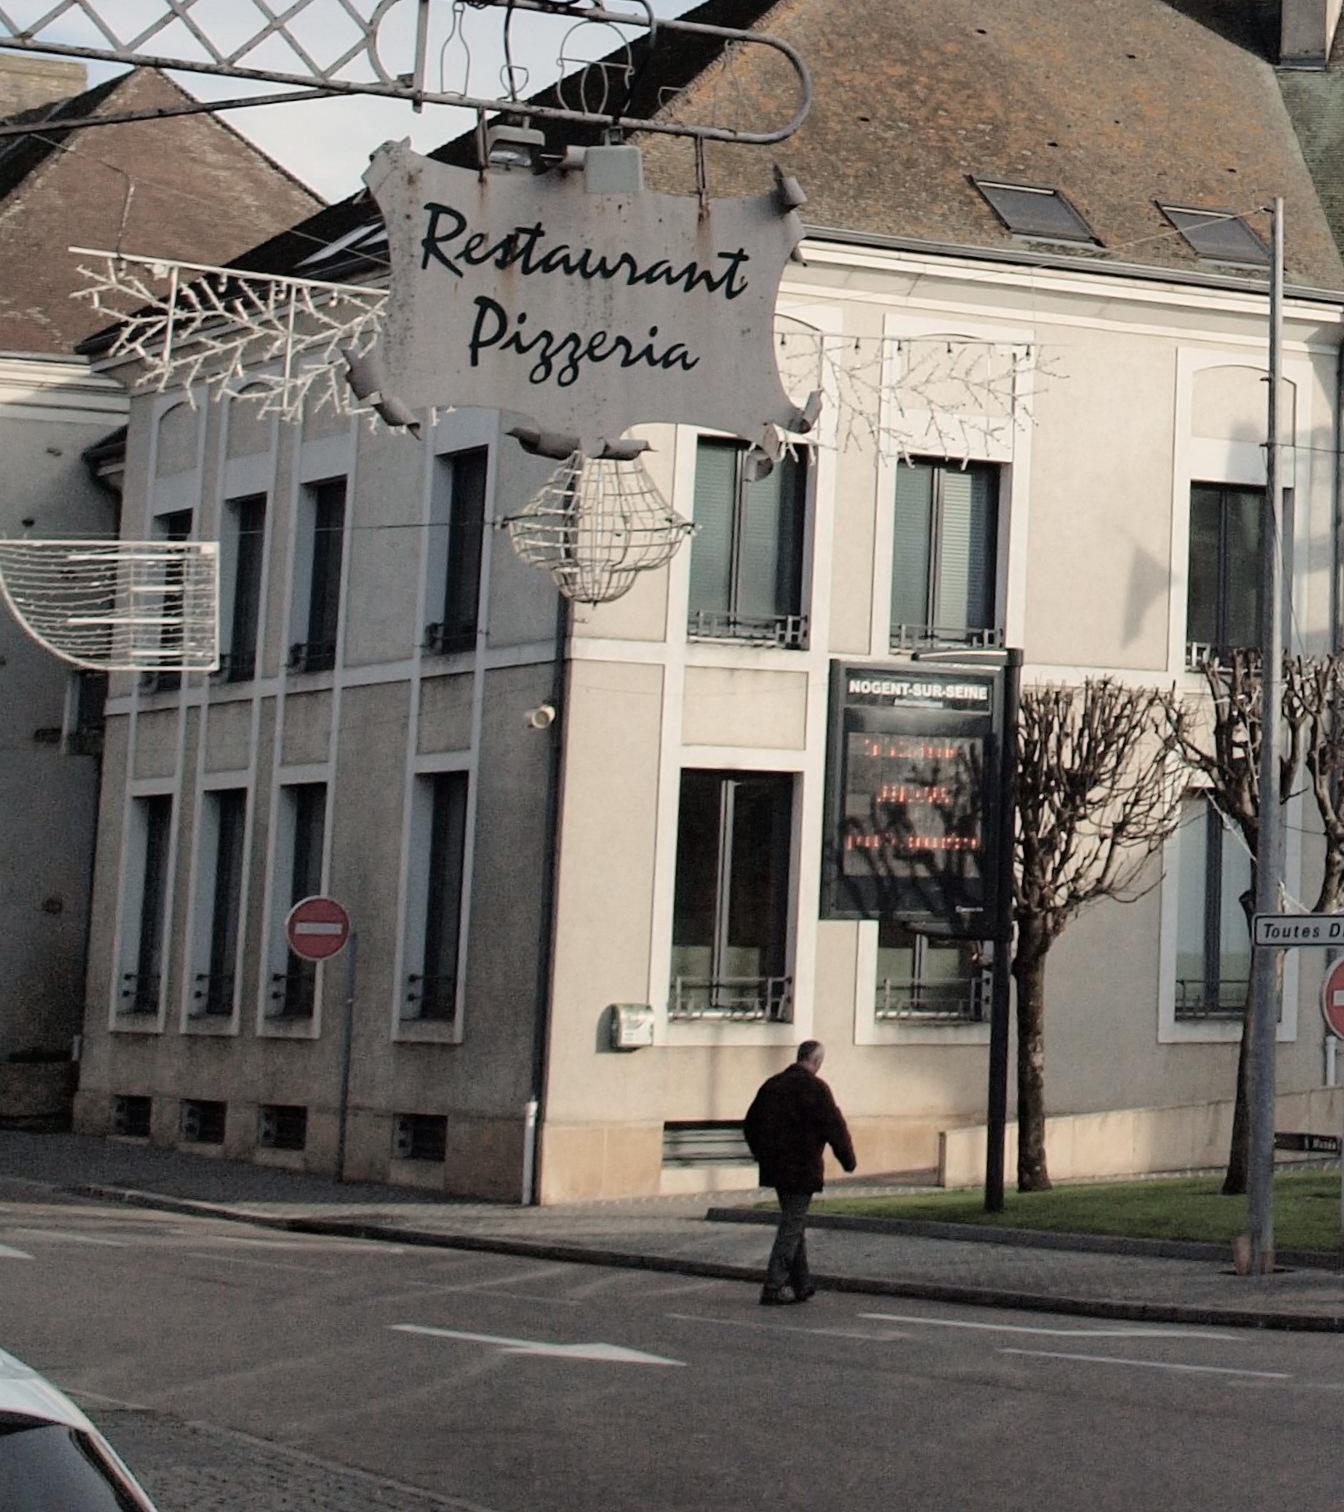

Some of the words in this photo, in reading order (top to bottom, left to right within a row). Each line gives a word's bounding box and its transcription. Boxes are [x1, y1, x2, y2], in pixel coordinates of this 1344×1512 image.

[421, 202, 749, 299] Restaurant
[469, 296, 699, 387] Pizzeria
[849, 680, 988, 700] NOGENT-SUR-SEINE
[1264, 923, 1320, 939] Toutes
